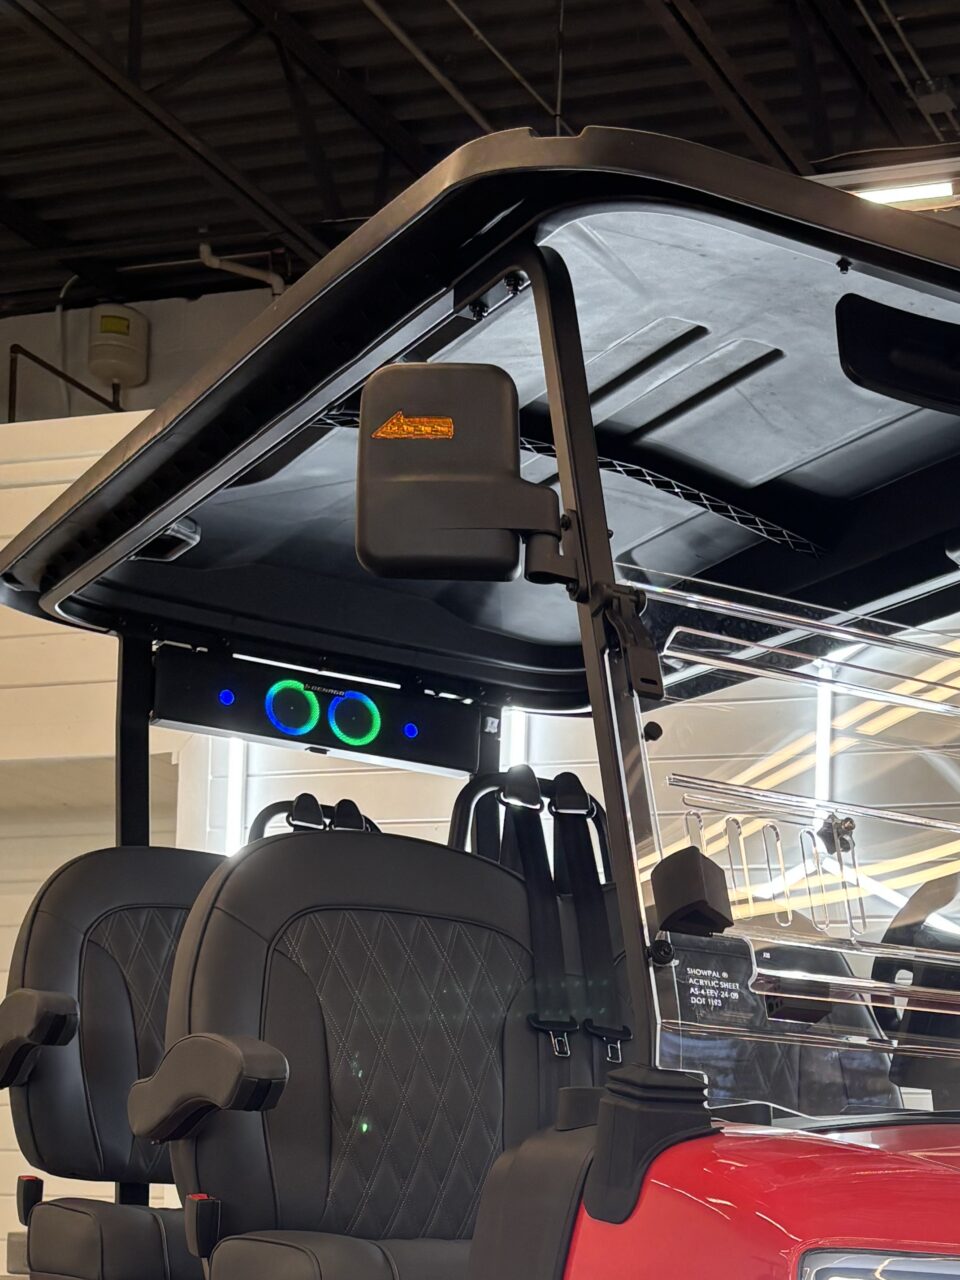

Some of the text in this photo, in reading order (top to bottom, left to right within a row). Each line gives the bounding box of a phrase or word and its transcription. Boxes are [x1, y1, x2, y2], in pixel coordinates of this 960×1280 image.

[687, 967, 721, 978] SHOWPAL
[688, 977, 740, 991] ACRYLIC SHEET
[690, 996, 706, 1005] DOT
